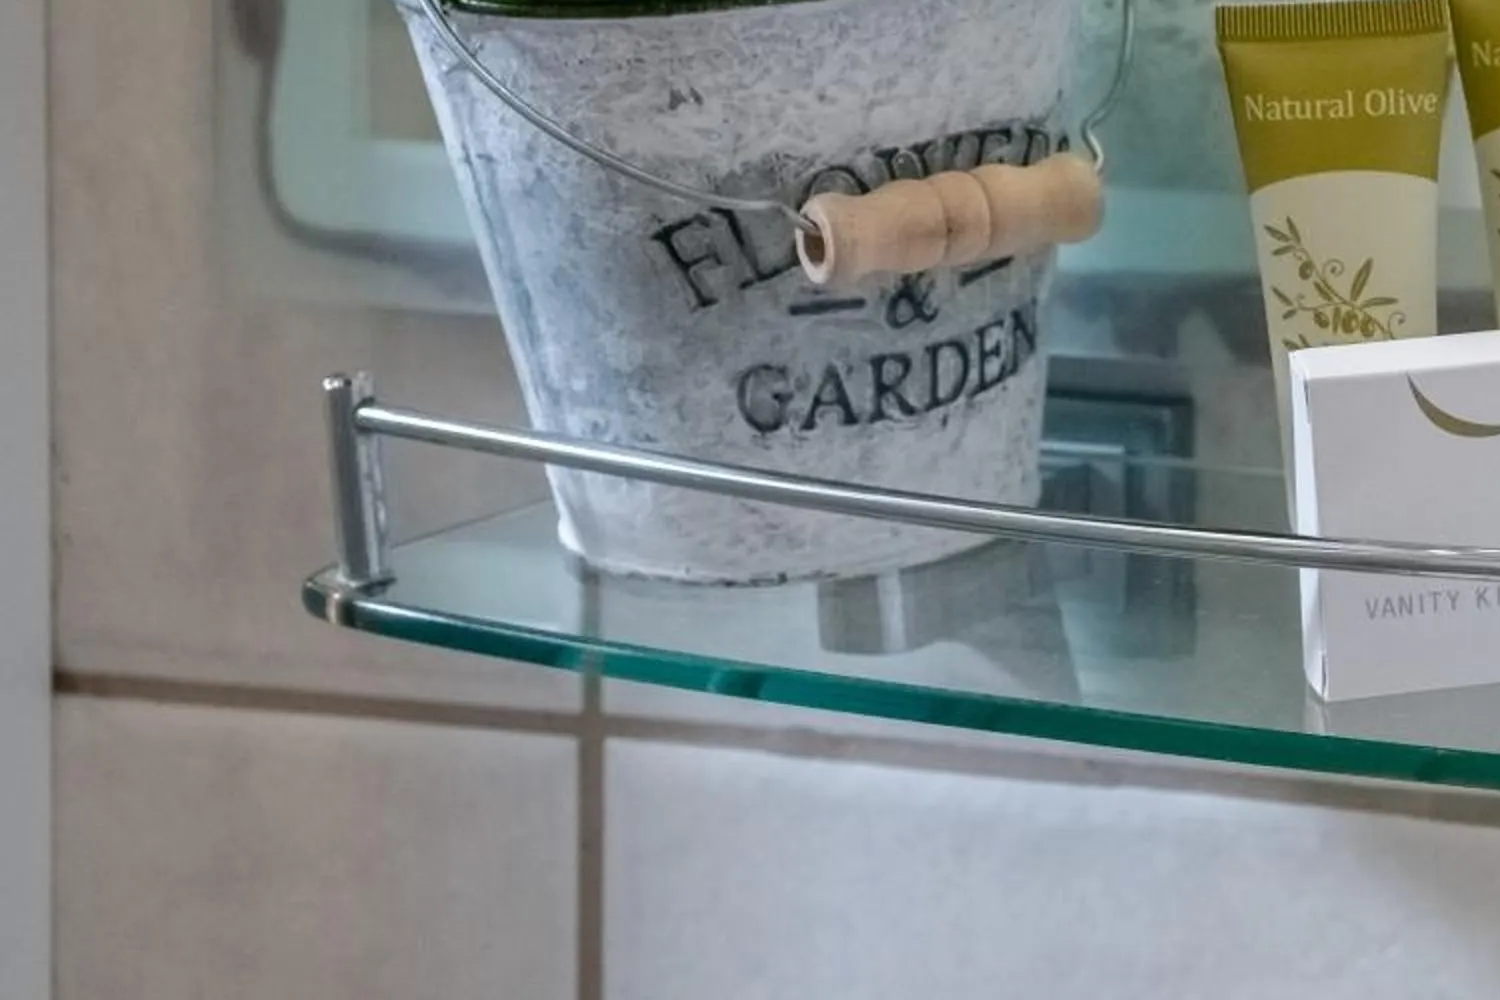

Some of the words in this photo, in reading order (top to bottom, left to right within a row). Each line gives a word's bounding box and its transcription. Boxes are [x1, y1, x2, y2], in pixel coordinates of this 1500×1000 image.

[1244, 90, 1354, 122] Natural
[1363, 88, 1439, 117] Olive
[883, 272, 940, 330] &
[736, 297, 1038, 433] GARDEN
[1365, 590, 1459, 620] VANITY
